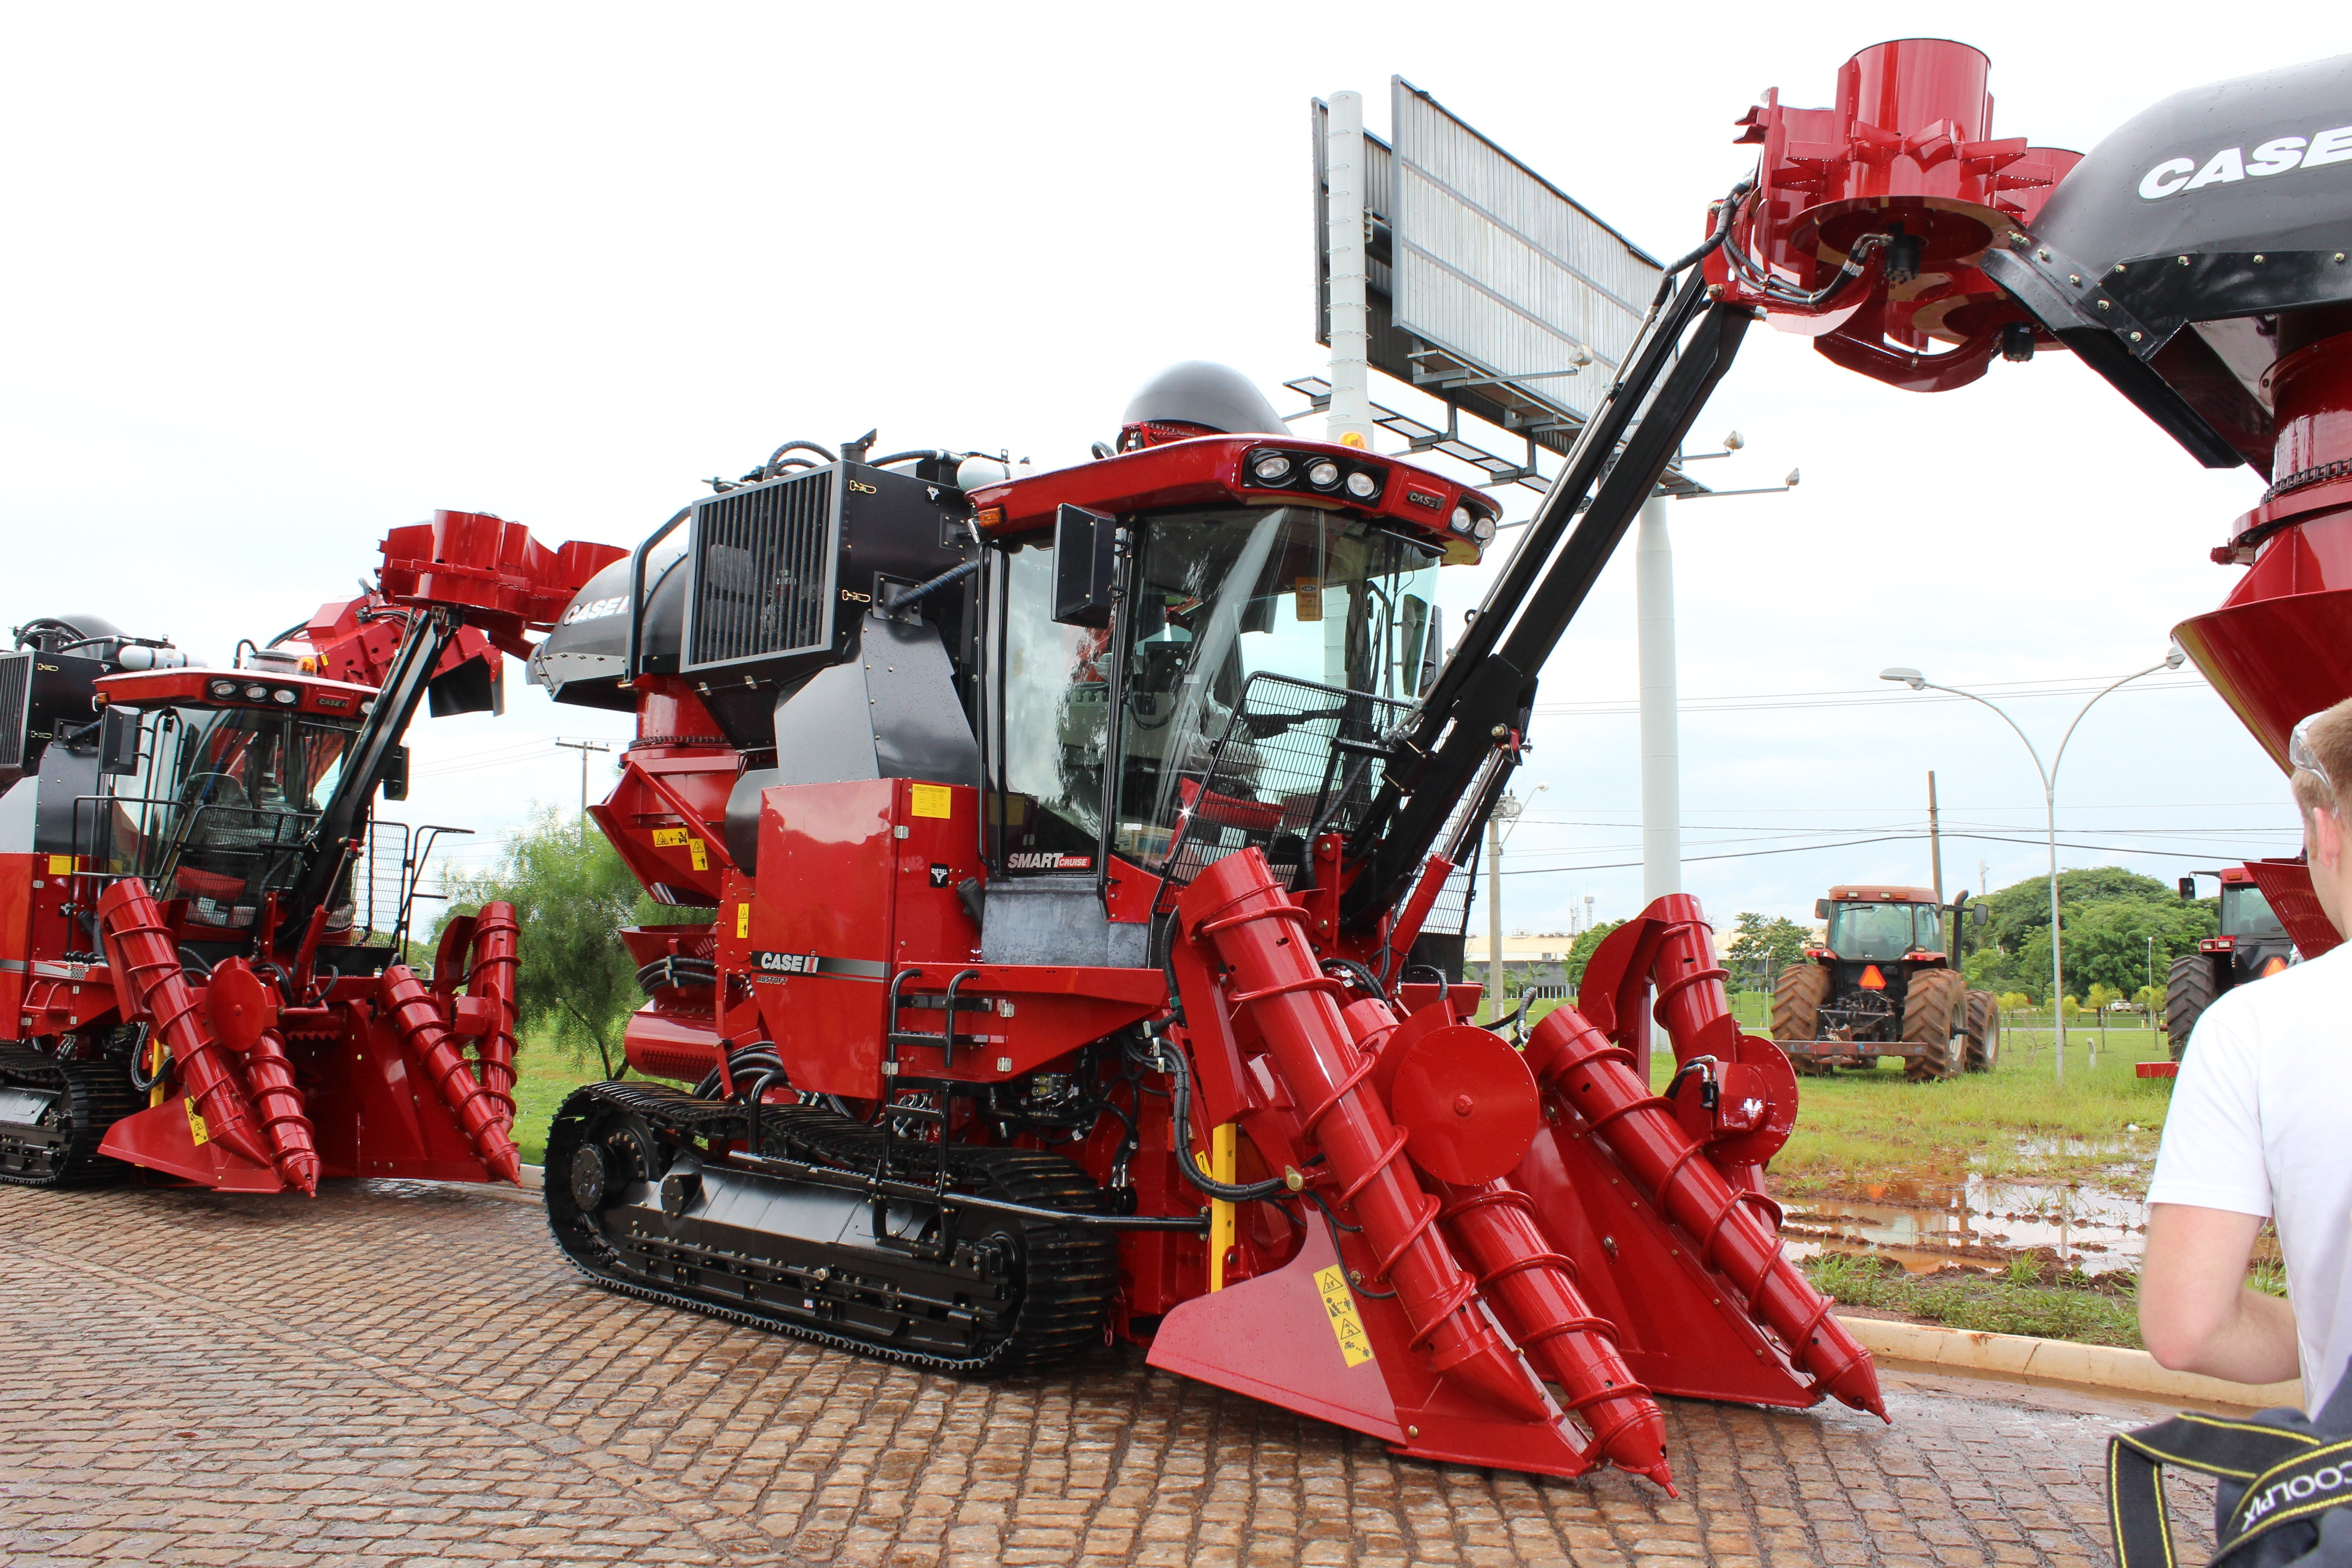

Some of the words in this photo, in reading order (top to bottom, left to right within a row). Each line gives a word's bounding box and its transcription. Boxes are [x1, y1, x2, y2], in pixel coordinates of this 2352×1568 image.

[2138, 126, 2352, 199] CASE
[563, 597, 623, 626] CASE
[1008, 853, 1064, 868] SMART
[1059, 858, 1088, 867] CRUISE
[761, 952, 804, 971] CASE
[70, 966, 86, 981] 8800
[756, 975, 788, 985] AUSTOFT
